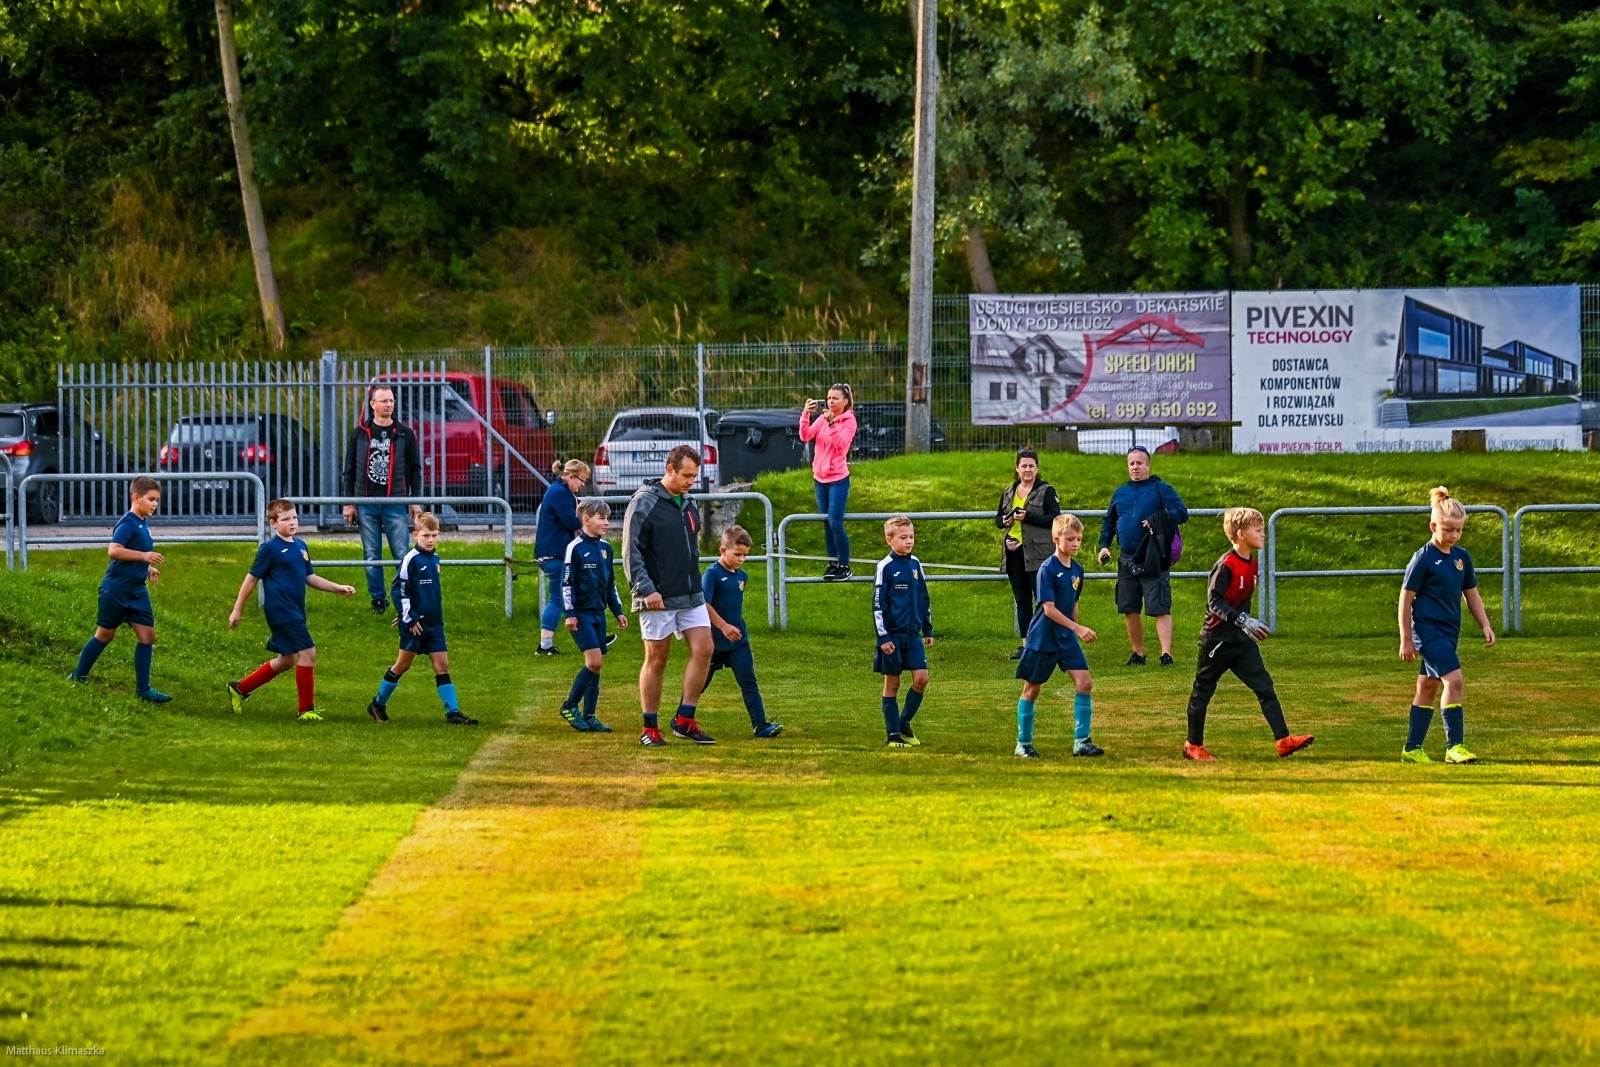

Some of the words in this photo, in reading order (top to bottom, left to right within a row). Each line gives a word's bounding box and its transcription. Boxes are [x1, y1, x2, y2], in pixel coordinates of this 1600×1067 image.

[975, 301, 1030, 315] USŁUGI
[1034, 300, 1123, 314] CIESIELSKO
[1136, 297, 1225, 314] DEKARSKIE
[975, 317, 1021, 331] DOMY
[1026, 317, 1059, 331] POD
[1063, 317, 1113, 330] KLUCZ
[1246, 305, 1354, 329] PIVEXIN
[1246, 330, 1353, 344] TECHNOLOGY
[1104, 353, 1197, 374] SPEED-DACH
[1272, 358, 1329, 372] DOSTAWCA
[1120, 373, 1150, 382] Marcin
[1152, 373, 1182, 382] Kaczor
[1260, 374, 1342, 391] KOMPONENTÓW
[1186, 381, 1213, 392] Nędza
[1267, 396, 1270, 409] I
[1273, 393, 1335, 411] ROZWIĄZAŃ
[1087, 403, 1111, 419] tel.
[1115, 402, 1147, 418] 698
[1151, 402, 1182, 418] 650
[1186, 401, 1218, 417] 692
[1258, 414, 1279, 427] DLA
[1281, 413, 1344, 427] PRZEMYSŁU
[1258, 442, 1343, 452] WWW.PIVEXIN-TECH.PL
[1239, 575, 1244, 589] 1
